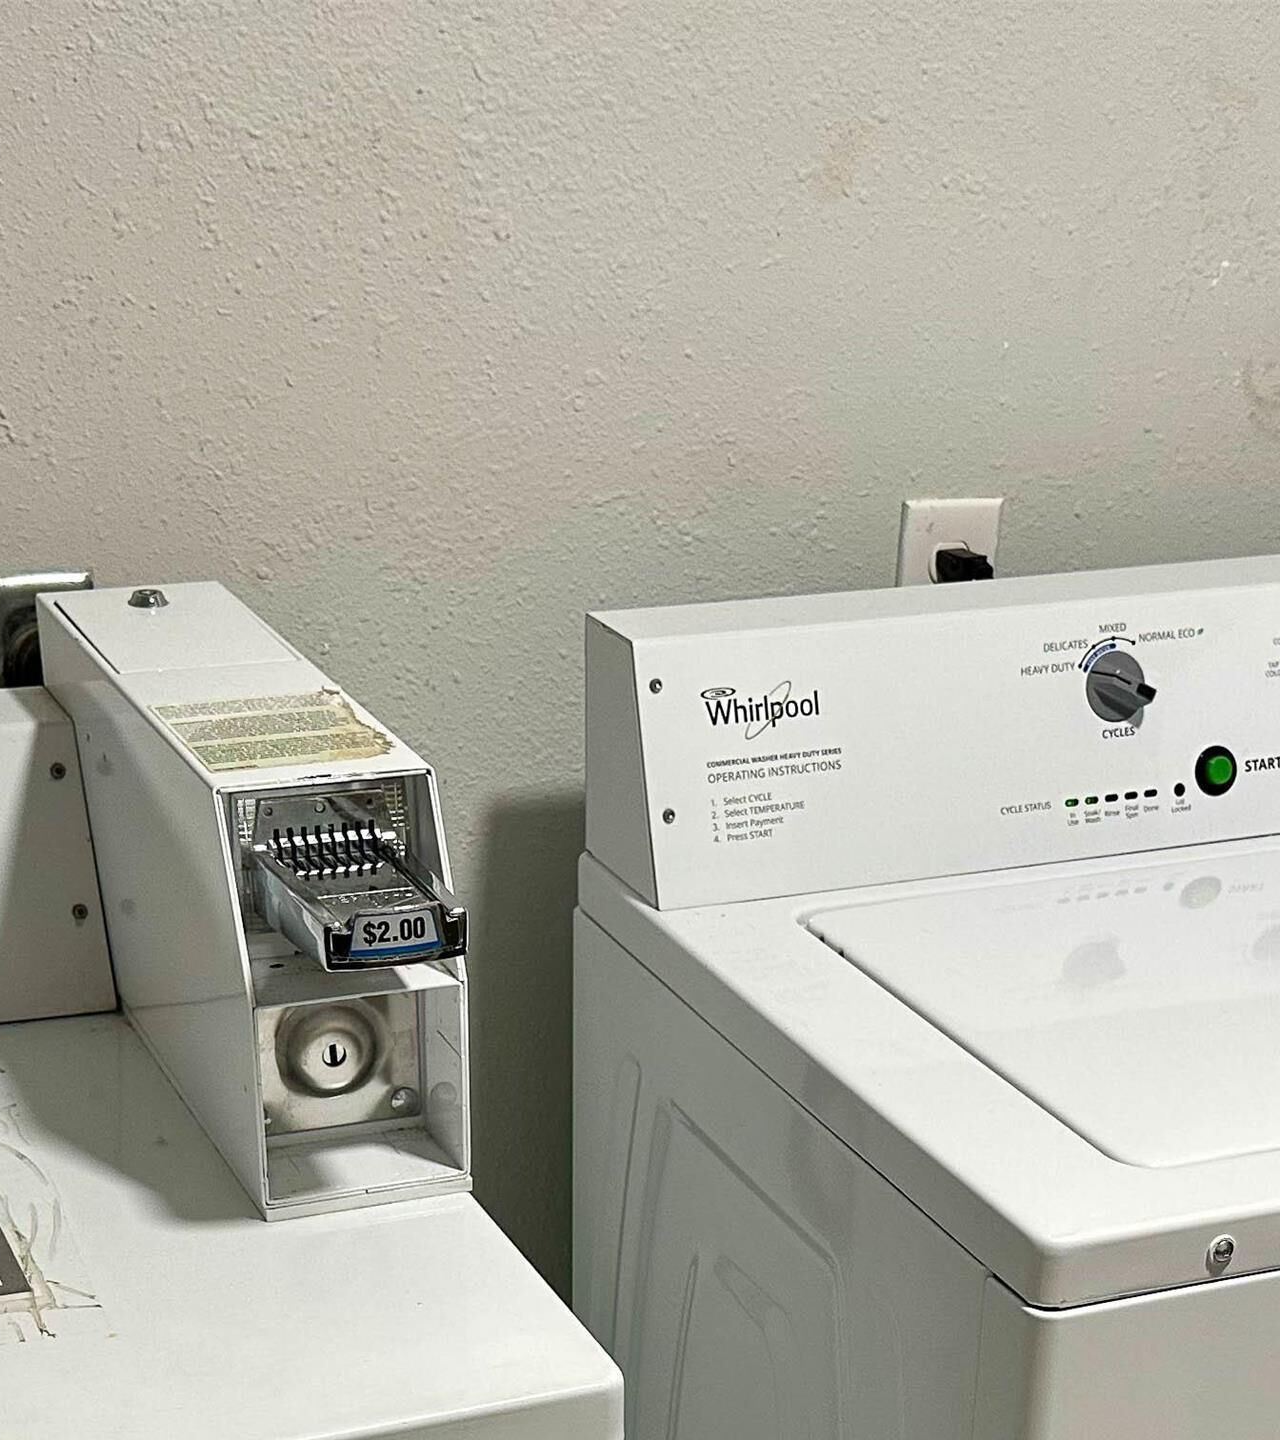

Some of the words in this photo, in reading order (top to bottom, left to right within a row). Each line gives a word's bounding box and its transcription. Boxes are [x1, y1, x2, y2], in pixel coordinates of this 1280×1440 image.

[1099, 623, 1126, 633] MIXED
[1138, 632, 1176, 643] NORMAL
[1178, 628, 1195, 638] ECO
[1043, 640, 1088, 653] DELICATES
[1020, 665, 1049, 676] HEAVY
[1051, 662, 1076, 673] DUTY
[704, 690, 820, 727] Whirlpool
[1102, 726, 1136, 739] CYCLES
[706, 757, 750, 769] COMMERCIAL
[751, 754, 778, 764] WASHER
[780, 751, 801, 760] HEAVY
[802, 749, 820, 758] DUTY
[821, 747, 842, 756] SERIES
[707, 768, 766, 784] OPERATING
[768, 760, 842, 777] INSTRUCTIONS
[724, 796, 747, 806] Select
[748, 792, 773, 803] CYCLE
[724, 807, 748, 818] Select
[749, 801, 805, 815] TEMPERATURE
[1000, 805, 1023, 815] CYCLE
[1024, 802, 1052, 812] STATUS
[725, 820, 748, 830] Insert
[750, 815, 784, 828] Payment
[727, 832, 748, 842] Press
[749, 829, 773, 840] START
[363, 916, 425, 947] $2.00
